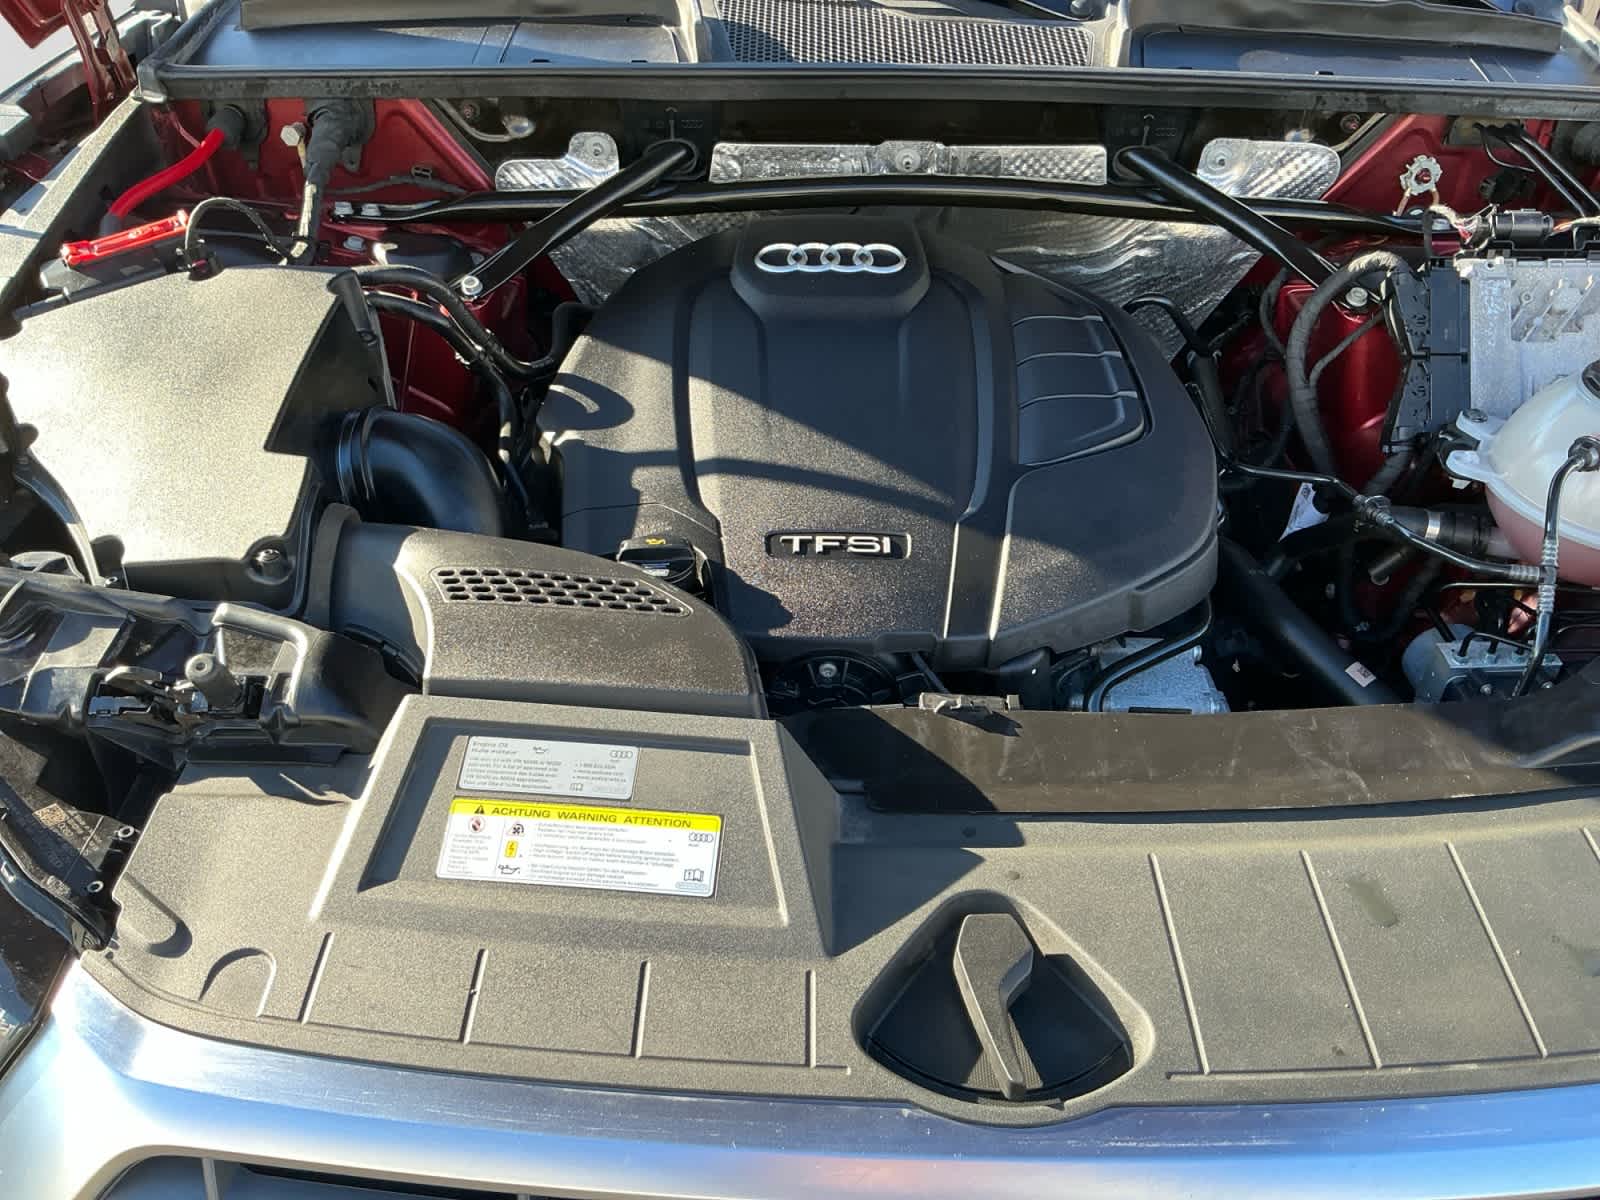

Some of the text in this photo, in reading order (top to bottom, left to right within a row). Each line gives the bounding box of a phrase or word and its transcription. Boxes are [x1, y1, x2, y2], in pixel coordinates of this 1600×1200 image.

[780, 535, 891, 554] TFSI
[491, 807, 551, 819] ACHTUNG
[557, 811, 617, 823] WARNING
[623, 815, 692, 829] ATTENTION
